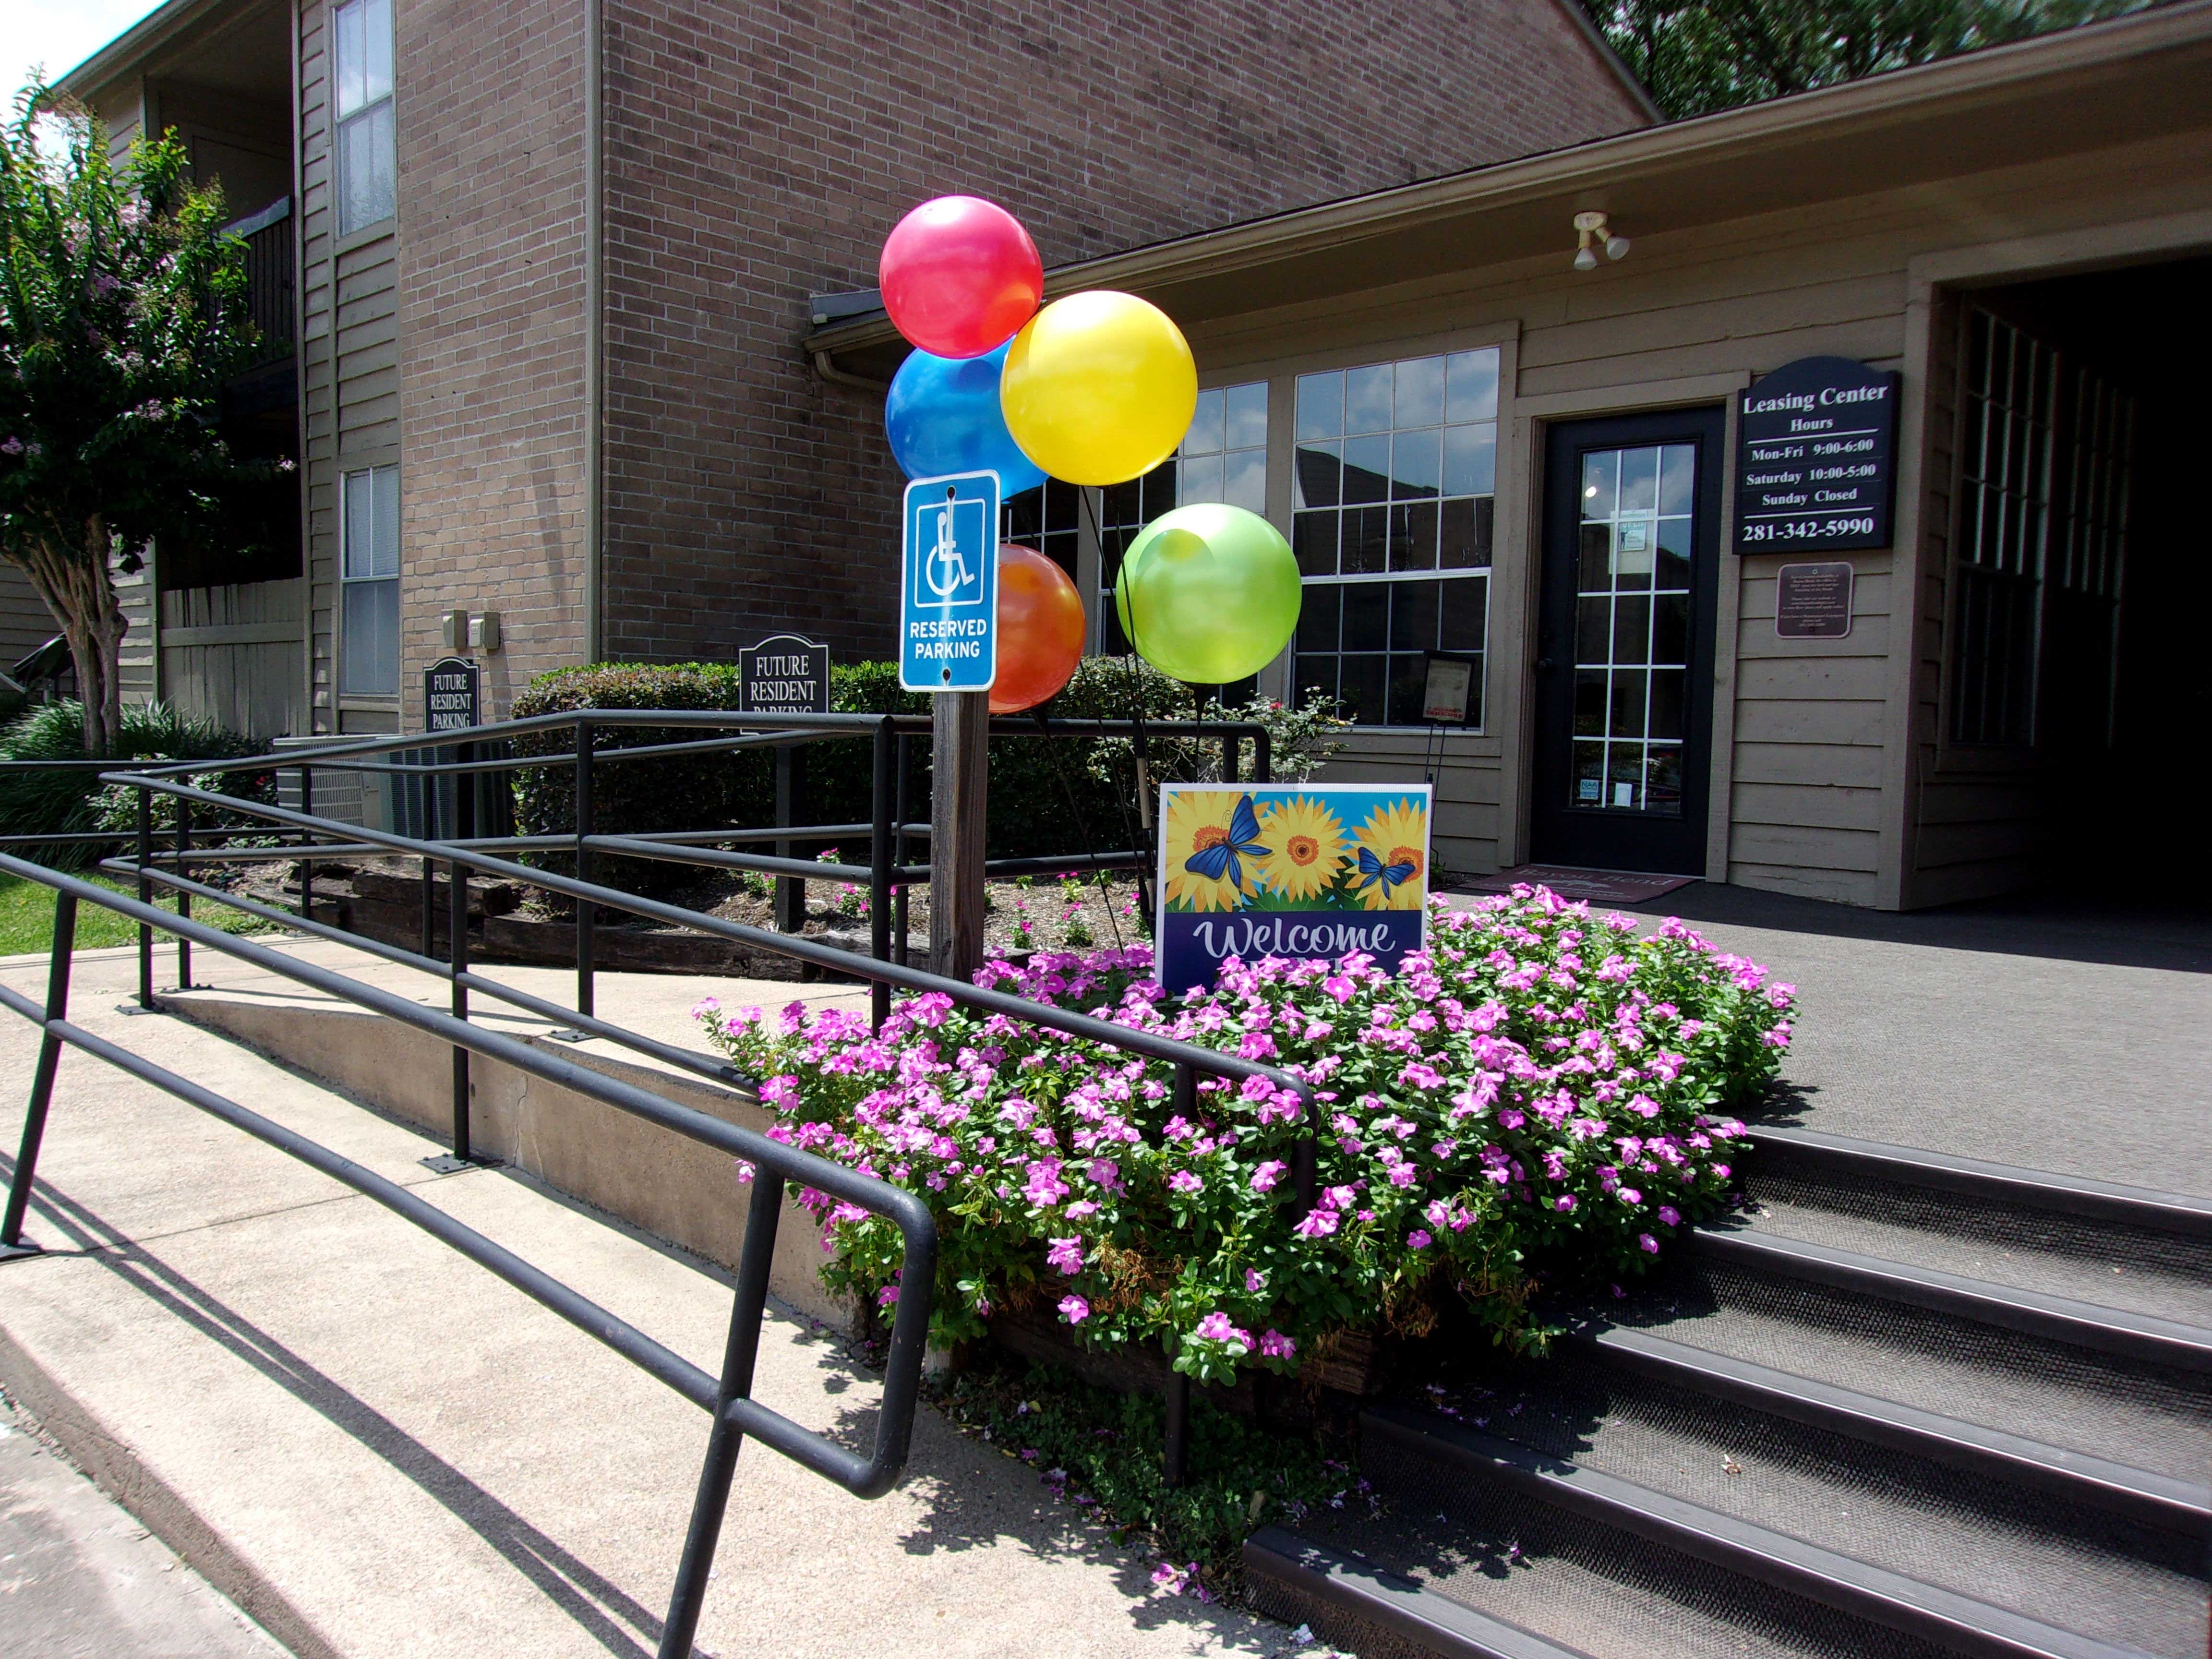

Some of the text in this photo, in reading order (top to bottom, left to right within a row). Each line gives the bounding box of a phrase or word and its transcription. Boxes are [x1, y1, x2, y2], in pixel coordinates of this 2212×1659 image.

[1743, 385, 1889, 414] Leasing Center
[1789, 419, 1834, 433] Hours
[1751, 438, 1874, 461] Mon-Fri 9:00-6:00
[1746, 464, 1876, 486] Saturday 10:00-5:00
[1762, 488, 1858, 506] Sunday Closed
[1742, 518, 1874, 541] 281-342-5990
[910, 618, 987, 638] RESERVED
[914, 641, 980, 659] PARKING
[756, 655, 810, 676] FUTURE
[434, 674, 468, 691] FUTURE
[750, 681, 817, 701] RESIDENT
[431, 694, 472, 710] RESIDENT
[433, 713, 470, 729] PARKING
[1193, 918, 1396, 958] Welcome
